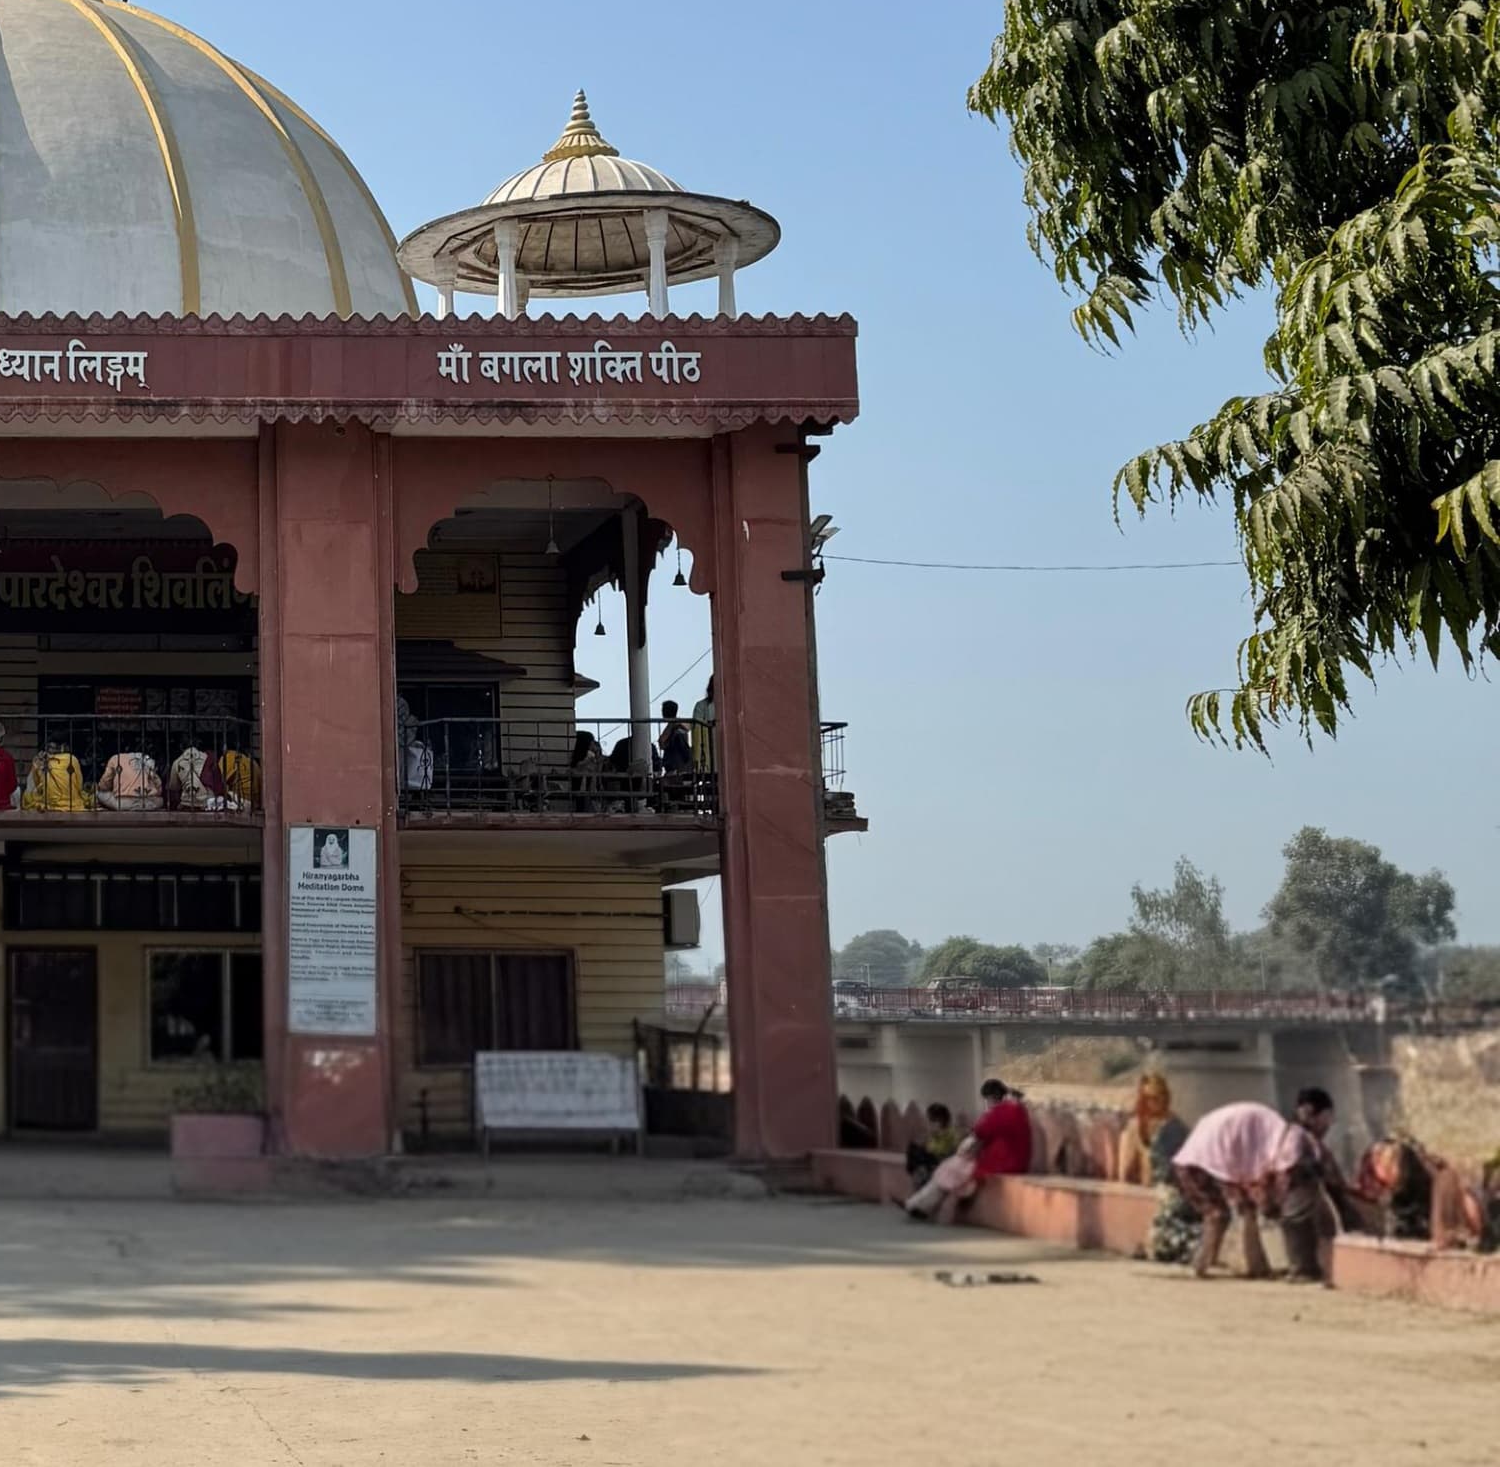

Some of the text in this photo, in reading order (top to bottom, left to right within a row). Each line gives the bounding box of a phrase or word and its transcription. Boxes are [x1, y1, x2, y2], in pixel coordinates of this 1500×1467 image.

[478, 350, 562, 384] बगला
[566, 339, 643, 386] शक्ति
[648, 340, 702, 384] पीठ
[297, 880, 365, 893] Meditation Dome
